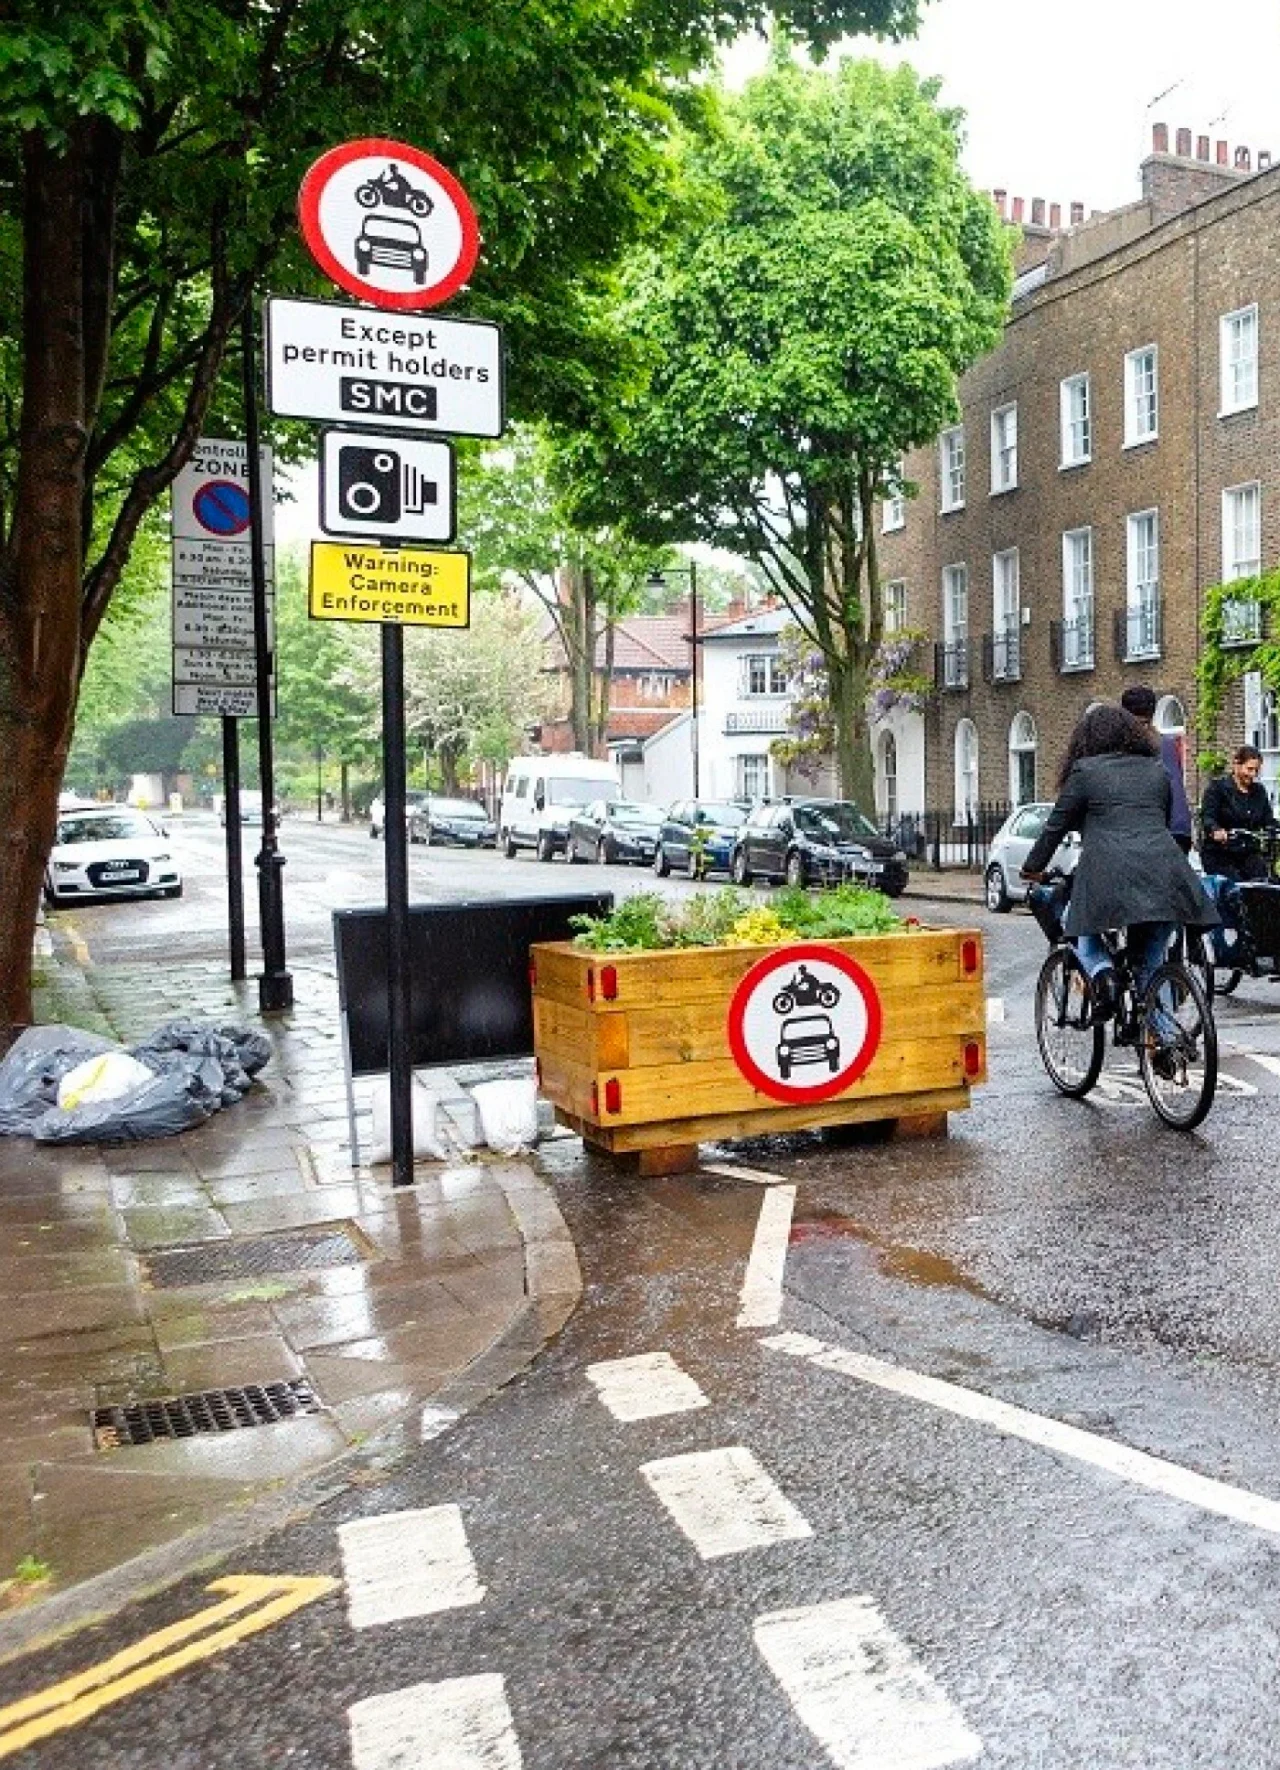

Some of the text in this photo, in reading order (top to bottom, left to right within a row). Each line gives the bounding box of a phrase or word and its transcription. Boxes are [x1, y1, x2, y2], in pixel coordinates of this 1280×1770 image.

[341, 317, 437, 350] Except
[283, 344, 490, 383] permit holders
[350, 382, 428, 415] SMC
[193, 459, 250, 477] ZONE
[350, 574, 433, 596] Camera
[321, 592, 459, 618] Enforcement
